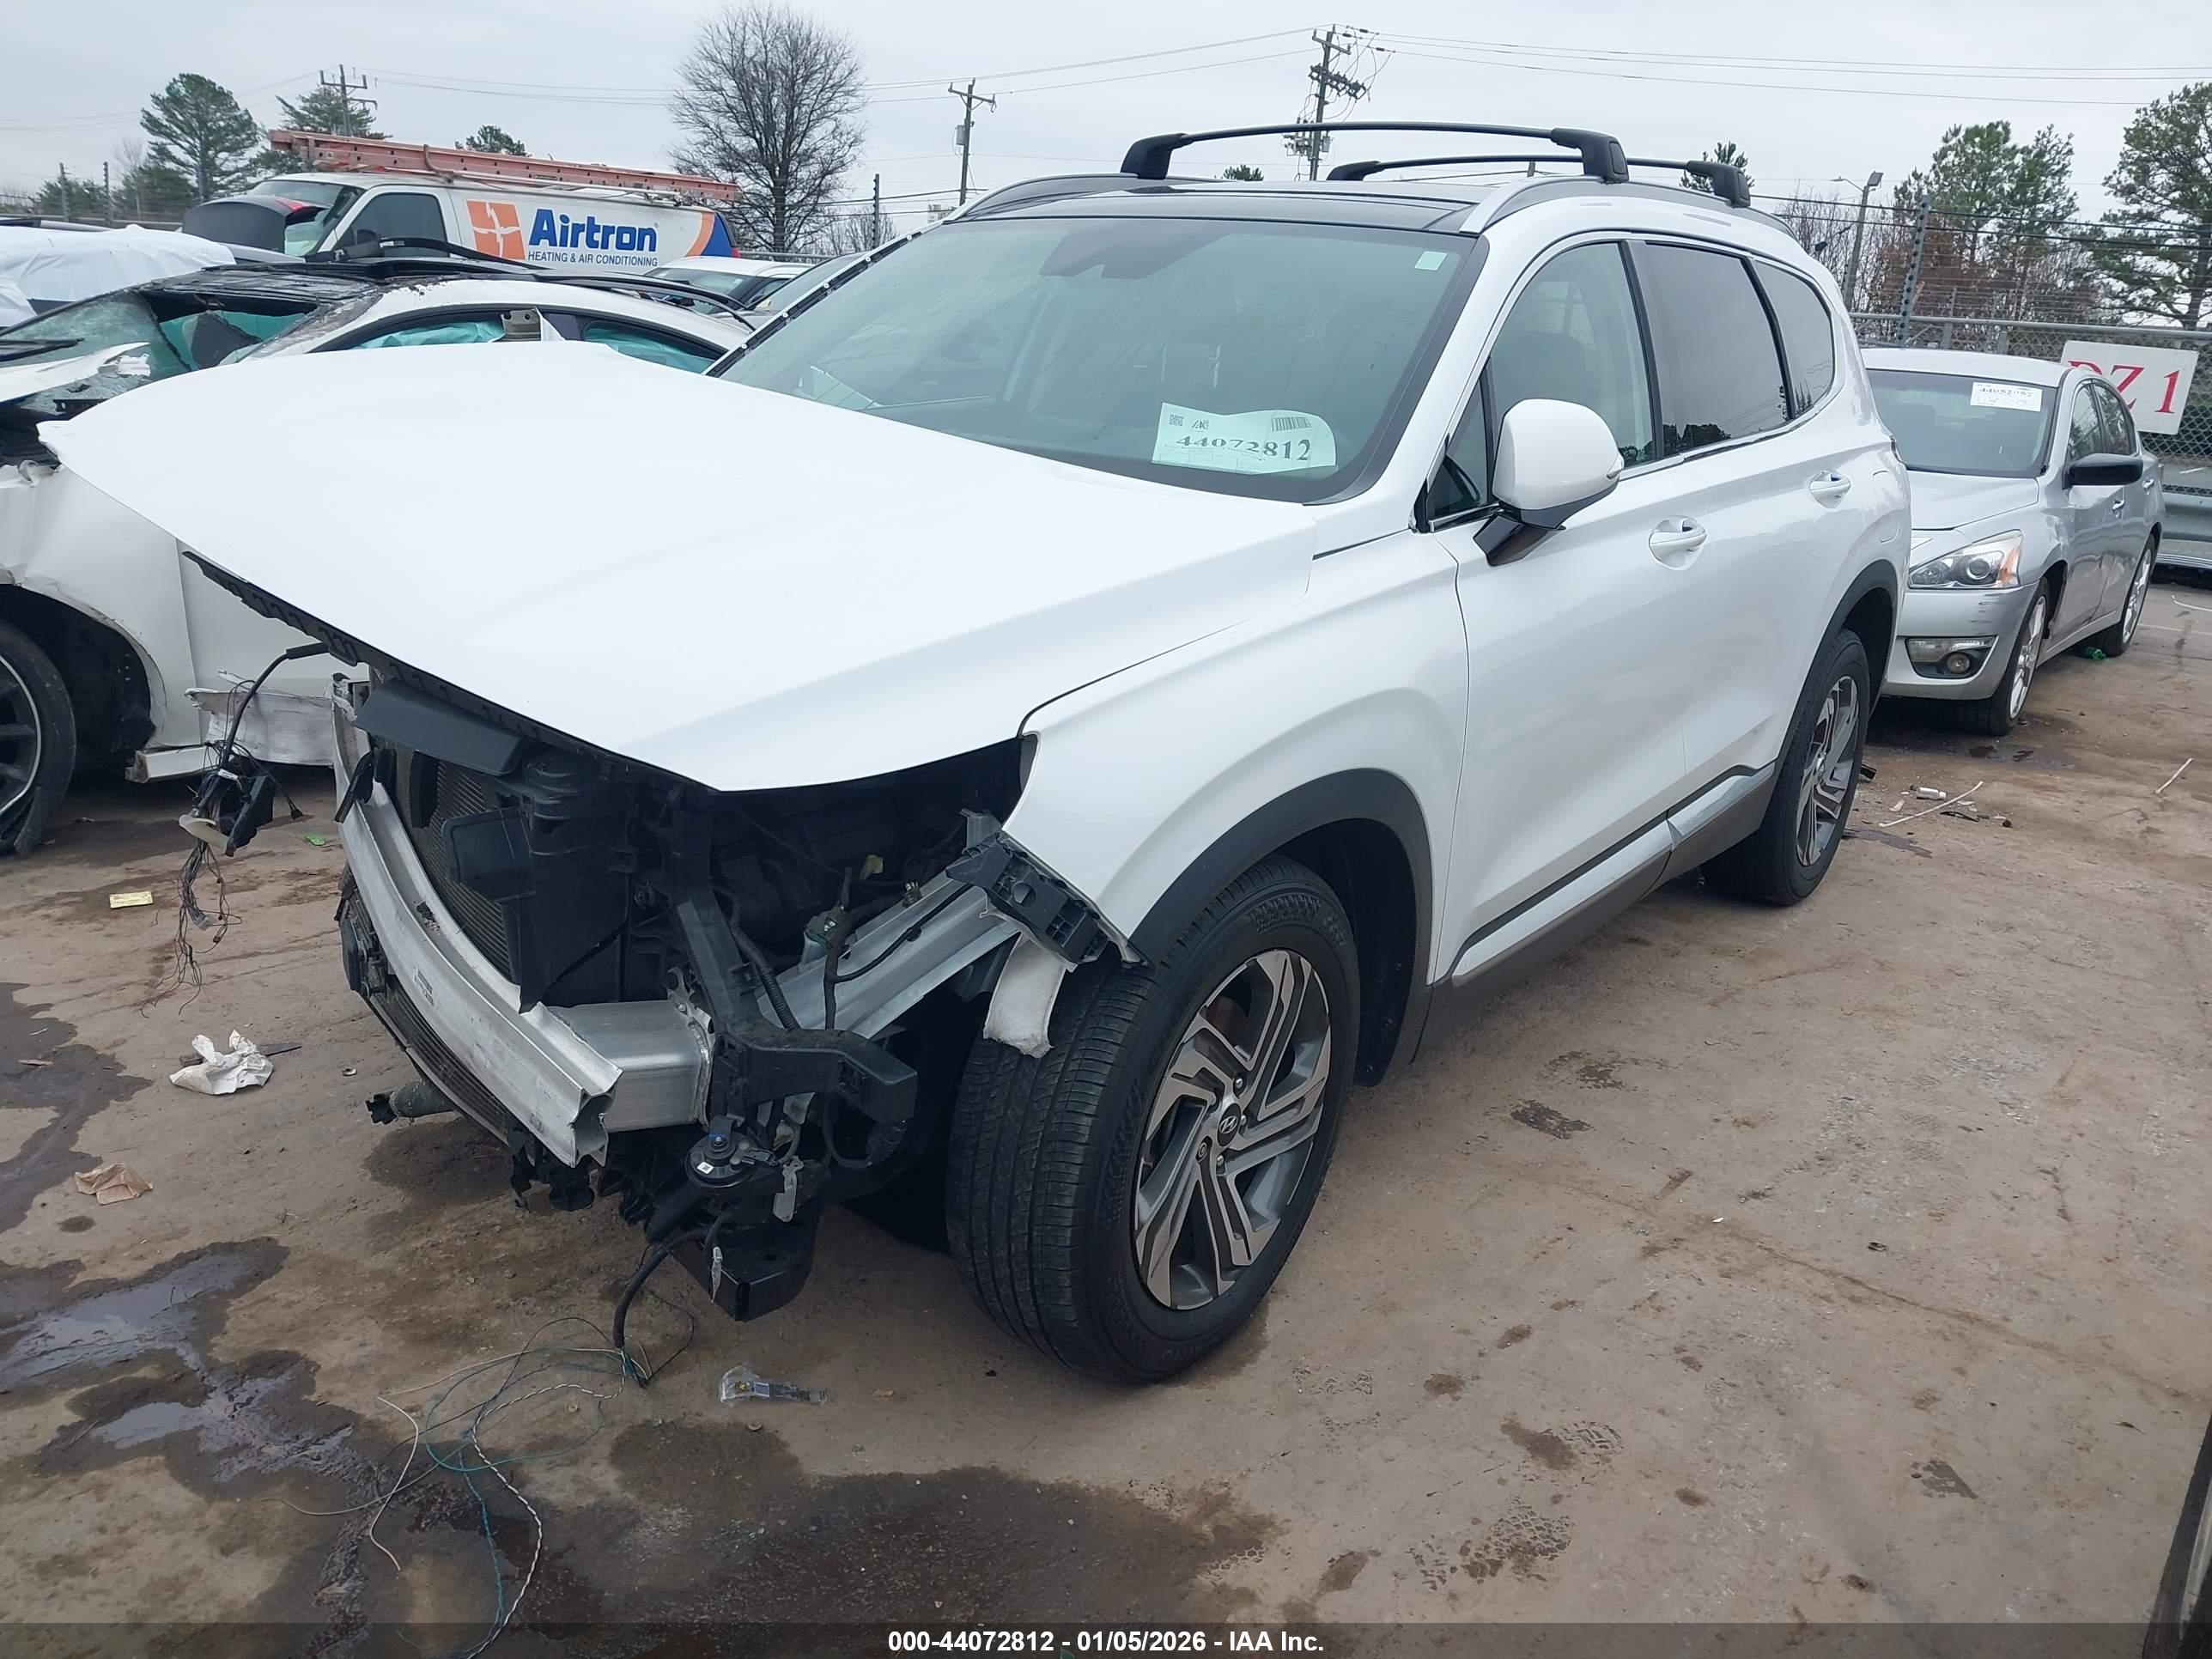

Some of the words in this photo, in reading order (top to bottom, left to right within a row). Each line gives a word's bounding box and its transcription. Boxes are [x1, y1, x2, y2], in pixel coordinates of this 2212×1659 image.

[528, 209, 657, 252] Airtron
[528, 251, 568, 263] HEATING
[570, 253, 577, 263] &
[579, 254, 592, 264] AIR
[595, 254, 659, 267] CONDITIONING
[2154, 369, 2180, 414] 1
[1176, 435, 1311, 461] 44072812
